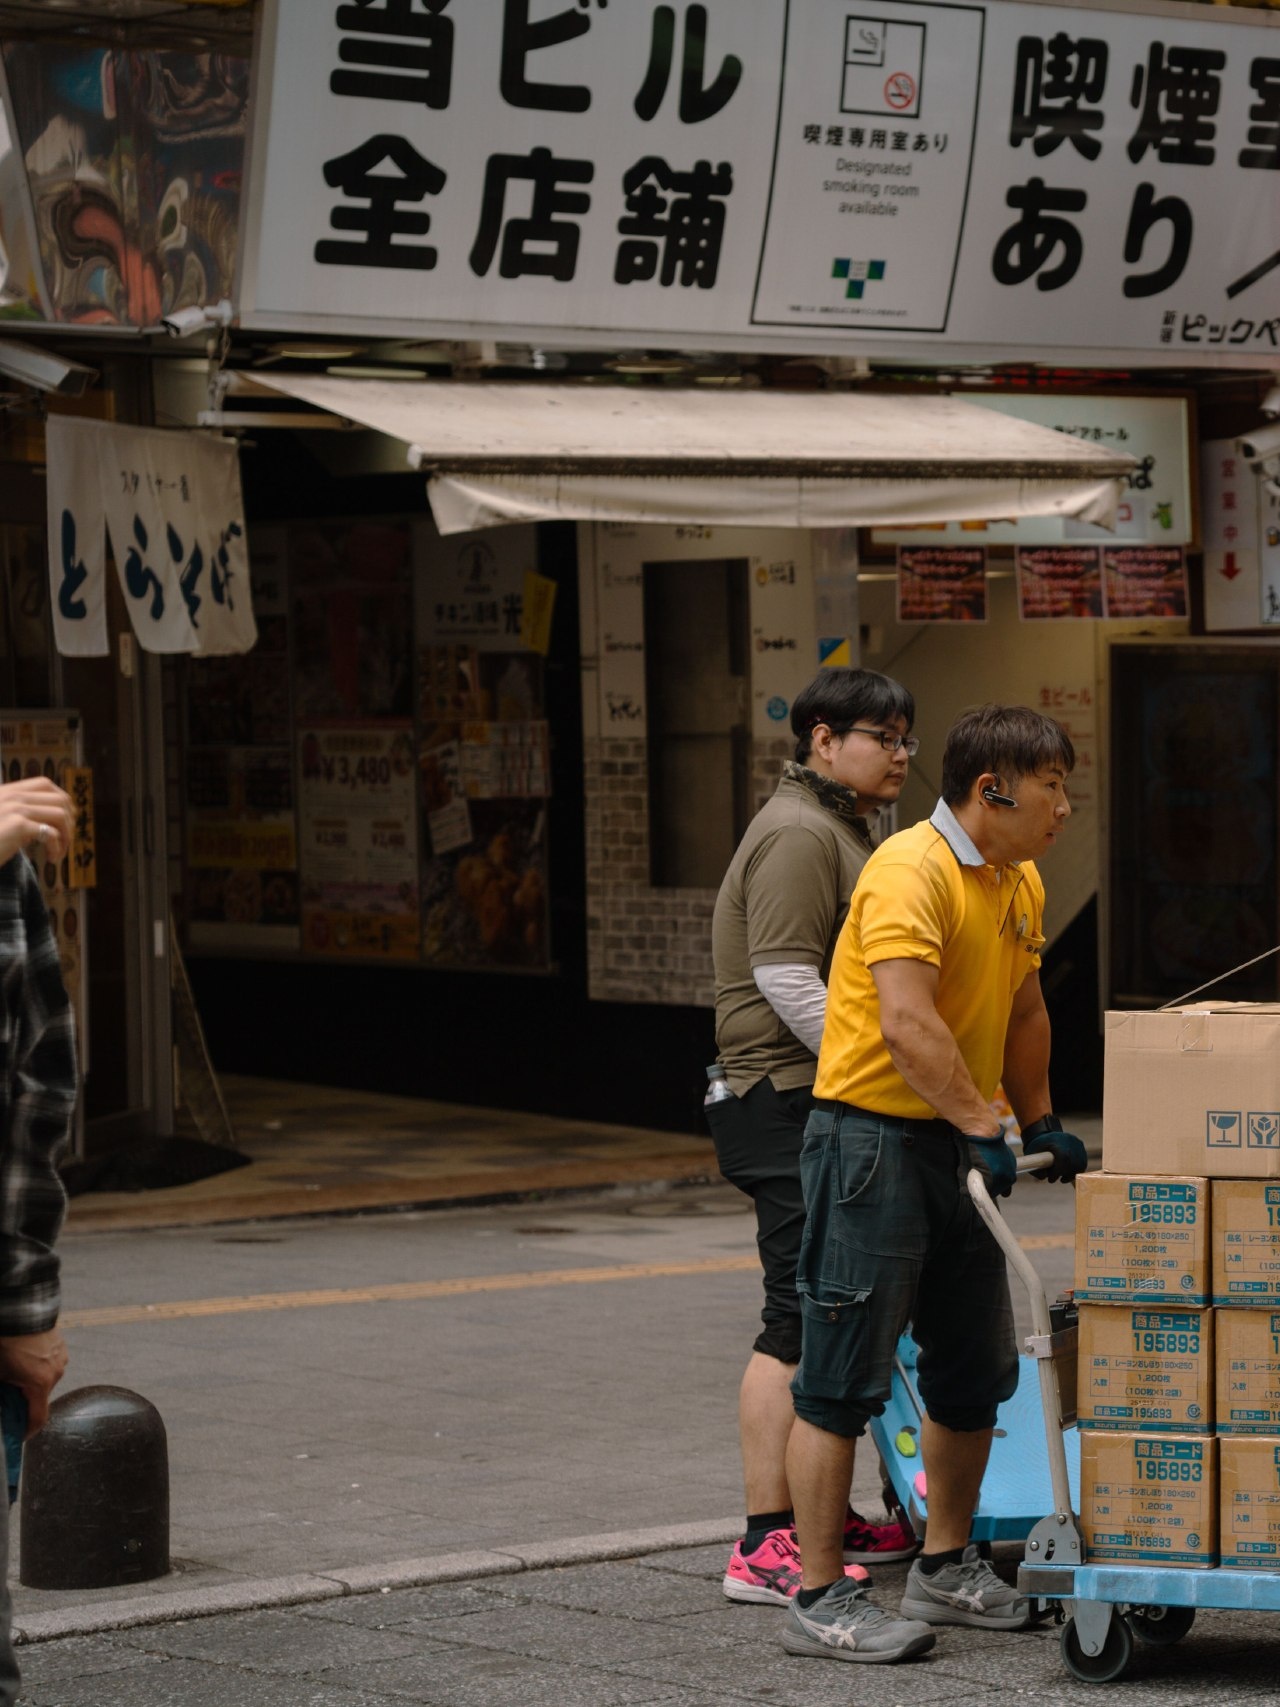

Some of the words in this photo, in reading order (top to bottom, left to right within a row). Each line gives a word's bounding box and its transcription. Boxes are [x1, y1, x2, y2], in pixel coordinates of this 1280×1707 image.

[329, 0, 742, 124] 当ビル
[803, 123, 948, 153] 喫煙専用室あり
[835, 157, 912, 177] Designated
[822, 179, 880, 197] smoking
[884, 182, 920, 196] room
[313, 132, 734, 290] 全店舗
[838, 200, 898, 216] available
[992, 177, 1194, 299] あり
[1131, 1185, 1195, 1200] 商品コード
[1134, 1314, 1199, 1330] 商品コード
[1134, 1332, 1199, 1354] 195893
[1134, 1408, 1170, 1417] 195893
[1137, 1442, 1201, 1458] 商品コード
[1136, 1460, 1202, 1482] 195893
[1133, 1537, 1171, 1547] 195893
